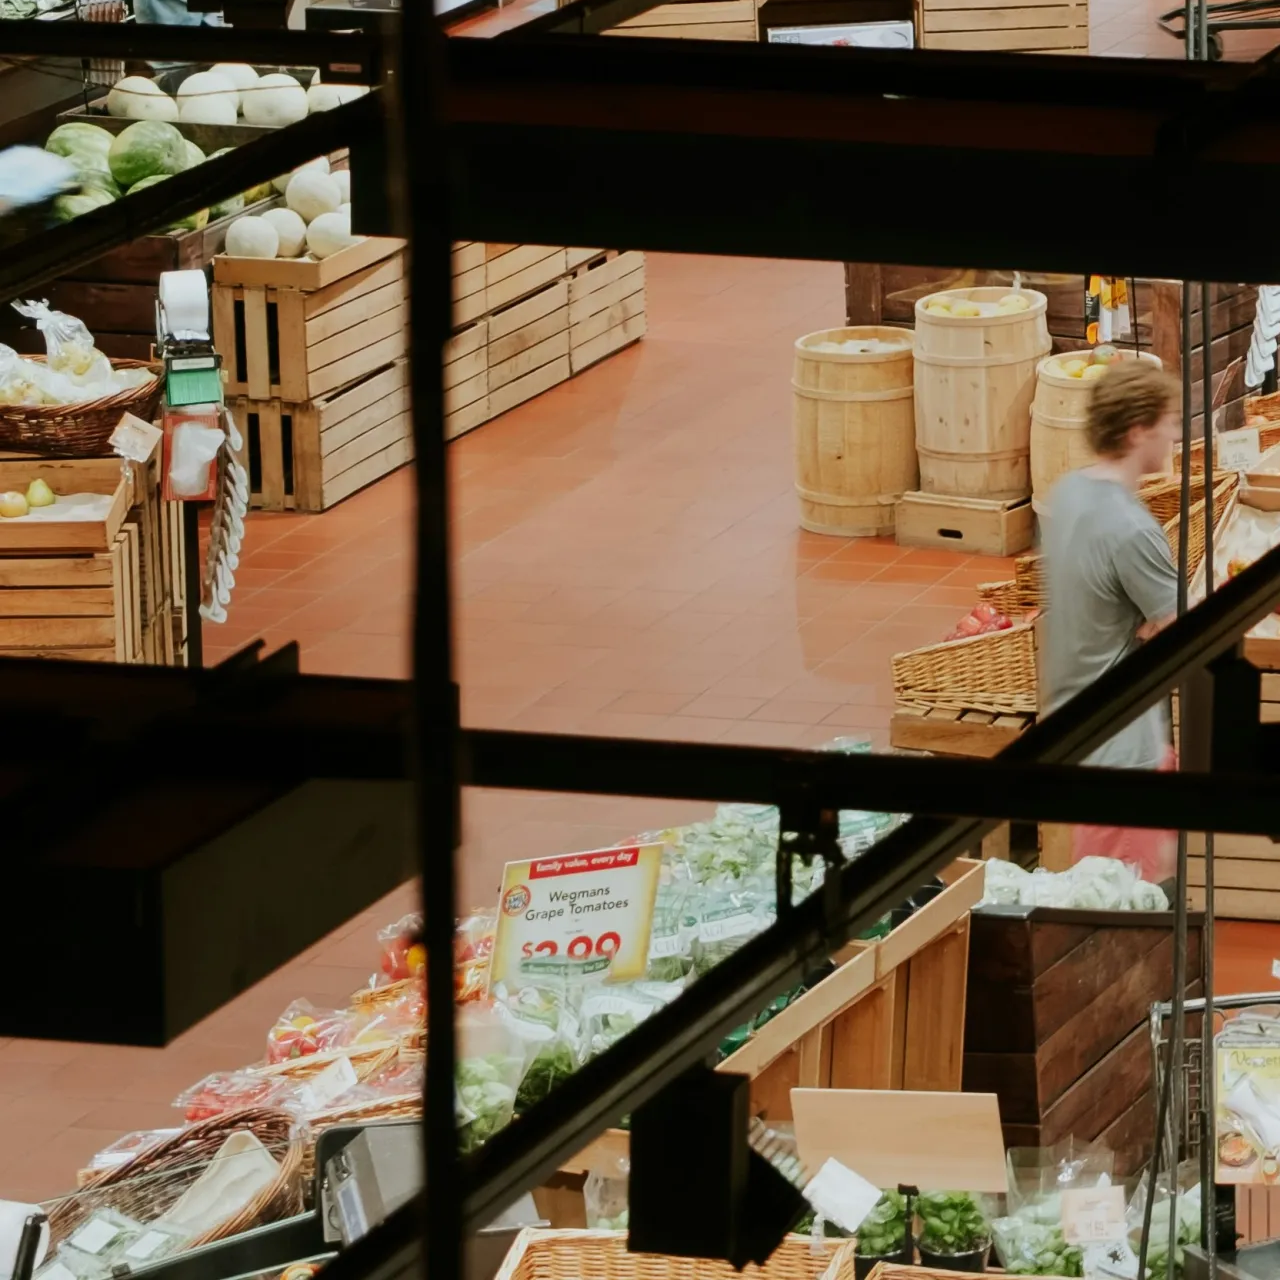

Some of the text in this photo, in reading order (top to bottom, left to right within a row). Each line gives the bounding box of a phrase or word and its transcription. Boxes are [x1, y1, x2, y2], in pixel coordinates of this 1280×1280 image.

[535, 862, 563, 873] family
[591, 855, 615, 866] every
[616, 851, 633, 862] day
[549, 885, 611, 905] Wegmans
[525, 899, 629, 922] Grape Tomatoes
